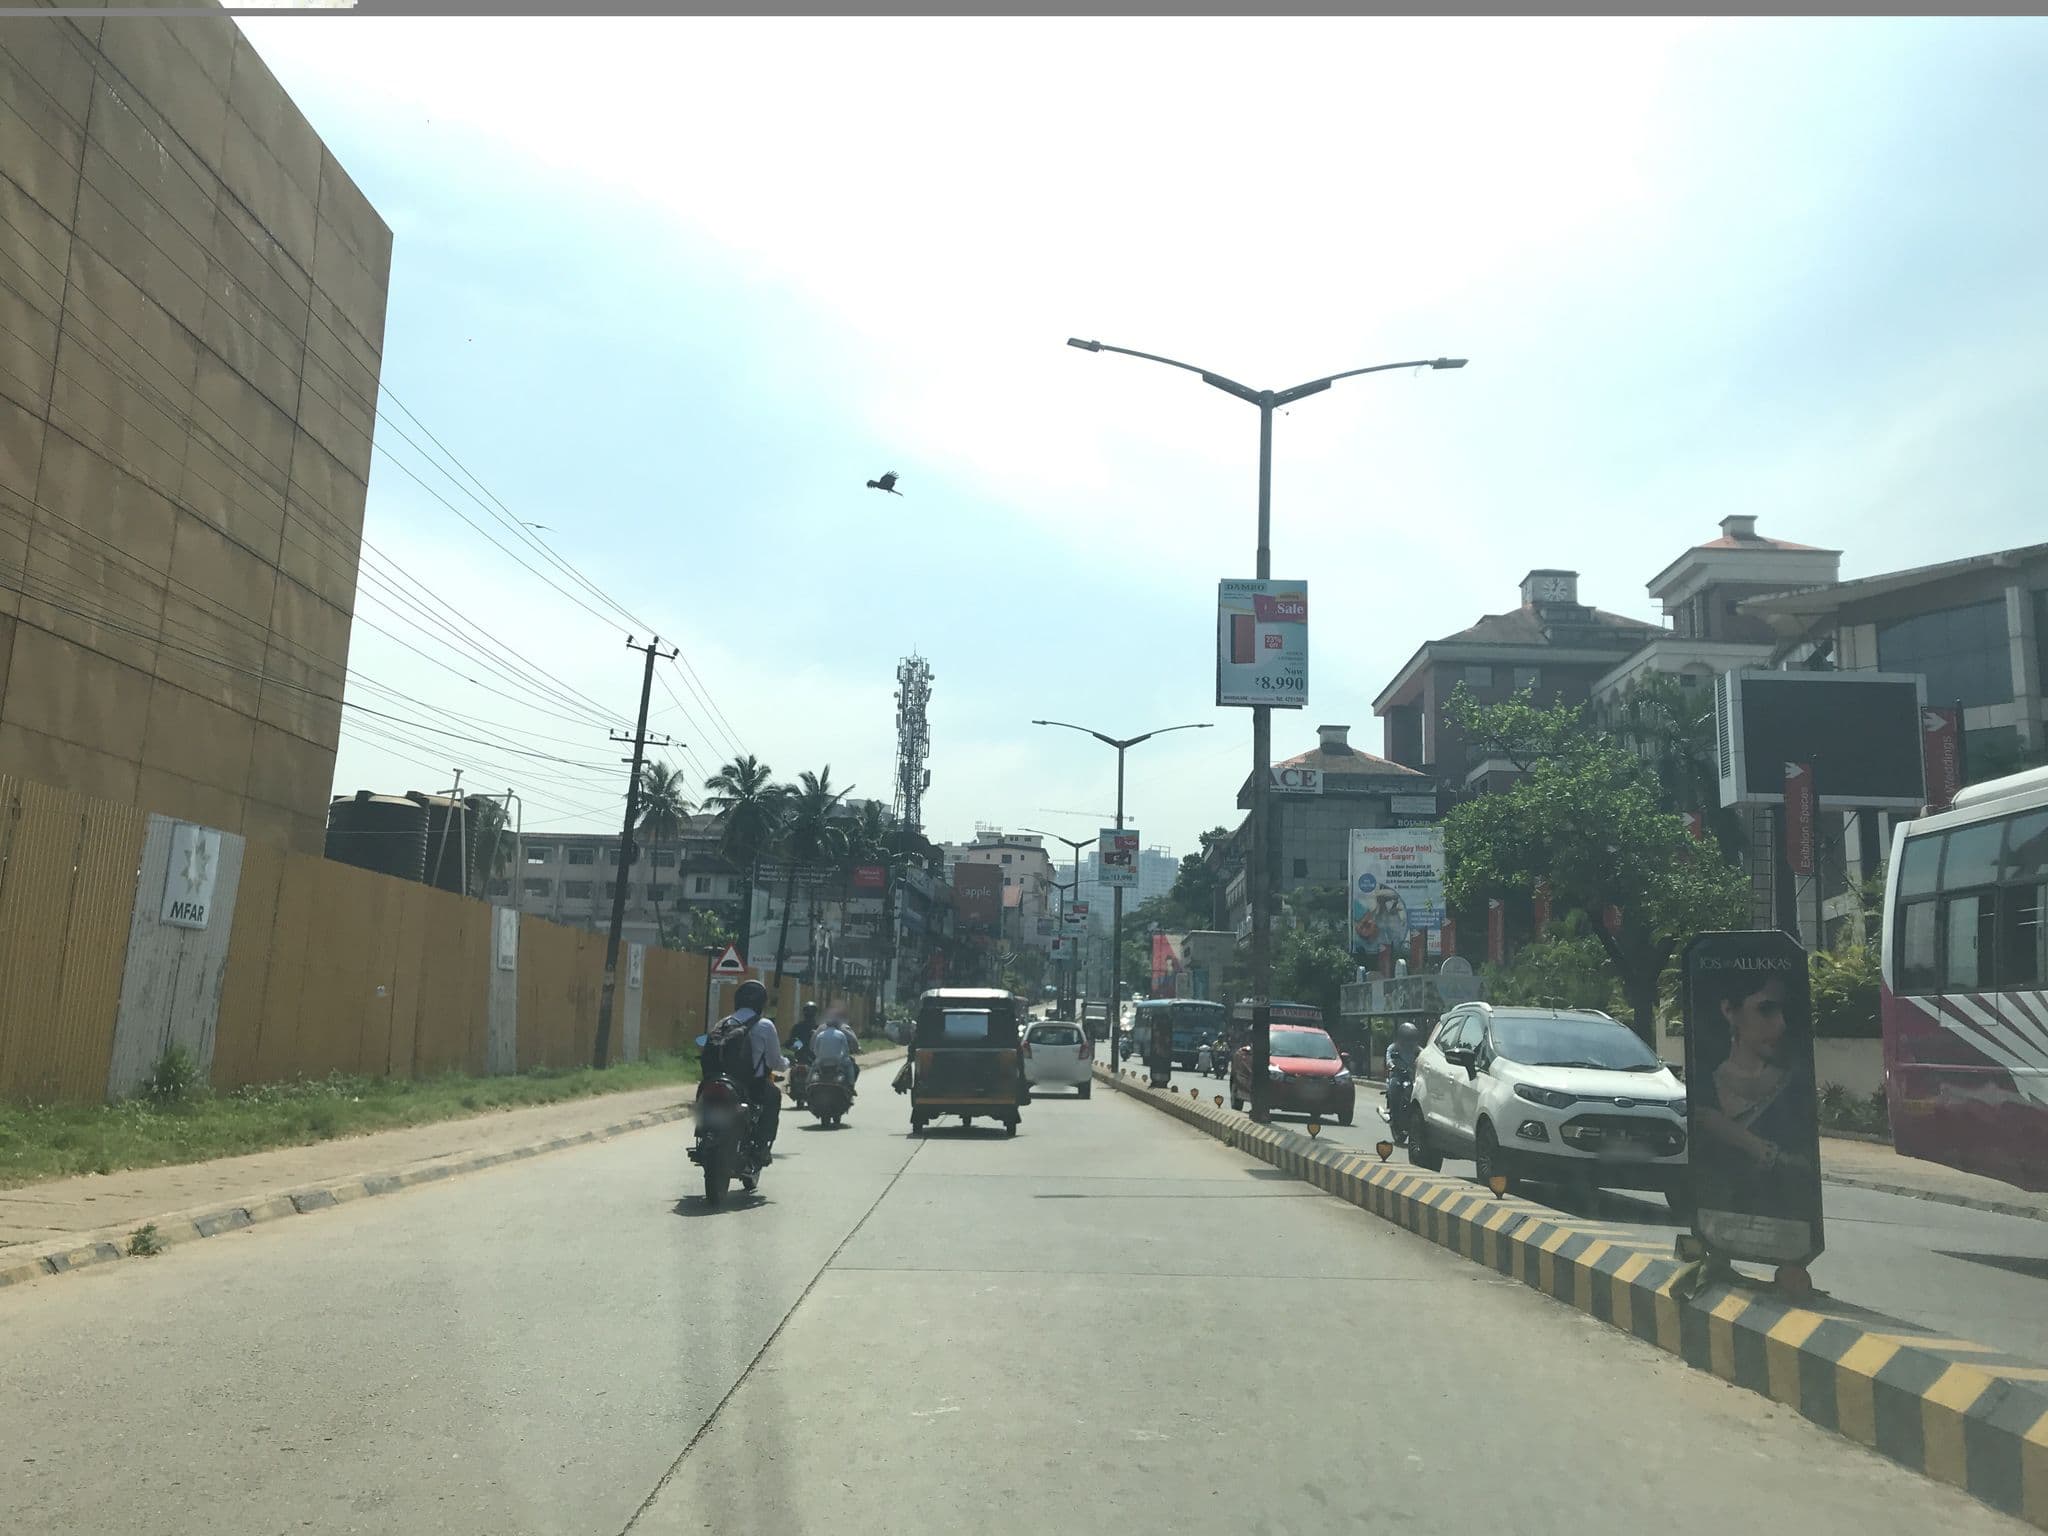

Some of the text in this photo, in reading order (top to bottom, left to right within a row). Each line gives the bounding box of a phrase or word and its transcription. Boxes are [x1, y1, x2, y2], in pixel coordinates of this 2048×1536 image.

[1277, 603, 1304, 615] Sale
[169, 900, 205, 922] MFAR
[1733, 956, 1792, 970] ALUKKAS
